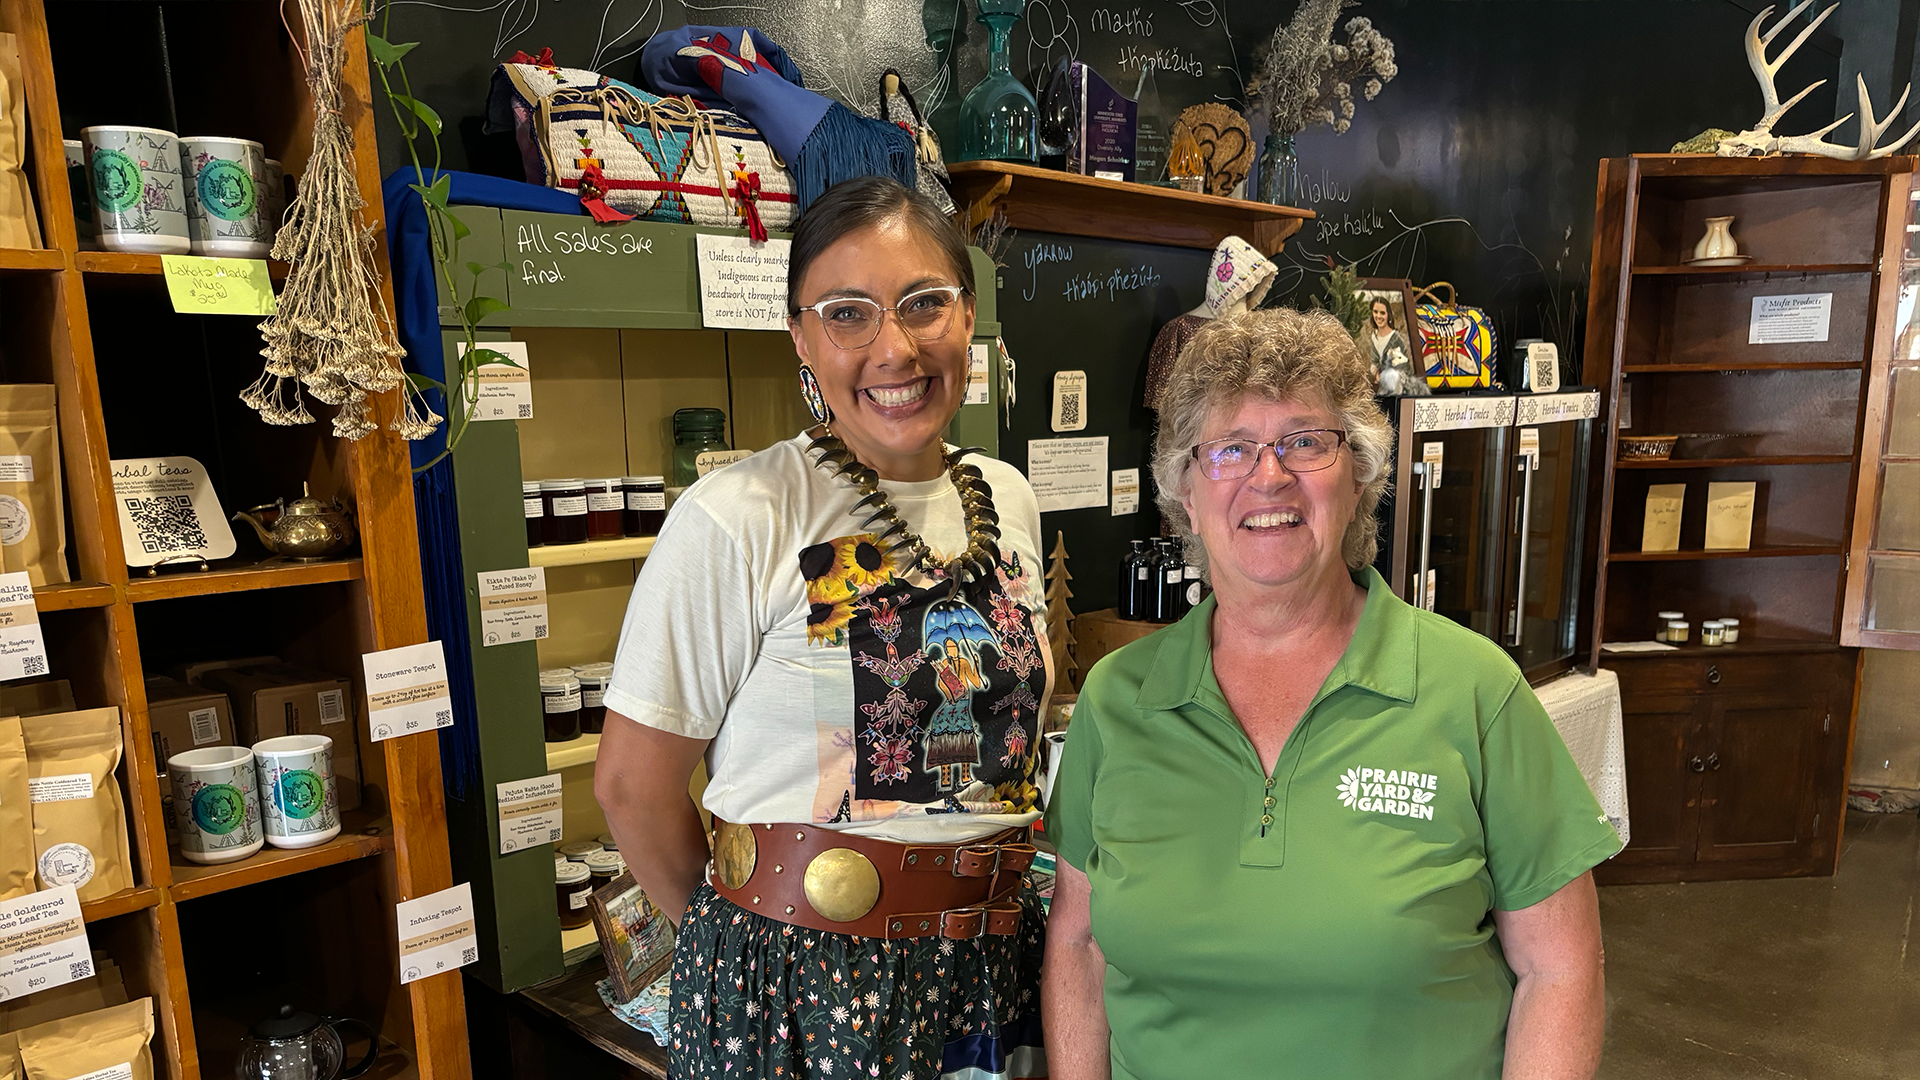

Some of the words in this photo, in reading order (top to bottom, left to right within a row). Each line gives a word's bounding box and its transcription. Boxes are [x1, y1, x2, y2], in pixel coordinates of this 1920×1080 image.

[517, 223, 552, 253] All
[553, 226, 618, 256] sales
[619, 233, 653, 255] are
[708, 249, 735, 262] Unless
[735, 250, 762, 267] clearly
[763, 253, 789, 270] marke
[167, 261, 213, 277] Lakota
[215, 265, 251, 280] Made
[522, 259, 567, 286] final.
[718, 268, 760, 285] Indigenous
[761, 274, 773, 283] art
[192, 277, 228, 299] Mug
[707, 285, 748, 304] beadwork
[748, 287, 789, 305] throughou
[1769, 297, 1791, 308] Misfit
[1792, 297, 1822, 306] Products
[715, 309, 735, 317] store
[735, 308, 743, 317] is
[744, 307, 766, 319] NOT
[767, 306, 780, 321] for
[1444, 405, 1468, 421] Herbal
[1468, 407, 1490, 420] Tonics
[1542, 399, 1560, 416] Herbal
[1561, 401, 1579, 414] Tonics
[112, 464, 151, 478] rbal
[156, 462, 193, 476] teas
[527, 573, 537, 581] Up)
[492, 583, 514, 591] Infused
[8, 639, 35, 647] Raspberry
[375, 668, 412, 680] Stoneware
[412, 663, 437, 674] Teapot
[406, 720, 419, 730] $35
[1360, 767, 1438, 790] PRAIRIE
[525, 789, 547, 799] Infused
[1360, 782, 1411, 801] YARD
[1411, 787, 1436, 804] &
[1358, 797, 1434, 821] GARDEN
[13, 898, 65, 916] Goldenrod
[19, 912, 41, 925] Leaf
[42, 909, 59, 919] Tea
[409, 912, 441, 927] Infusing
[440, 905, 463, 918] Teapot
[28, 976, 47, 989] $20
